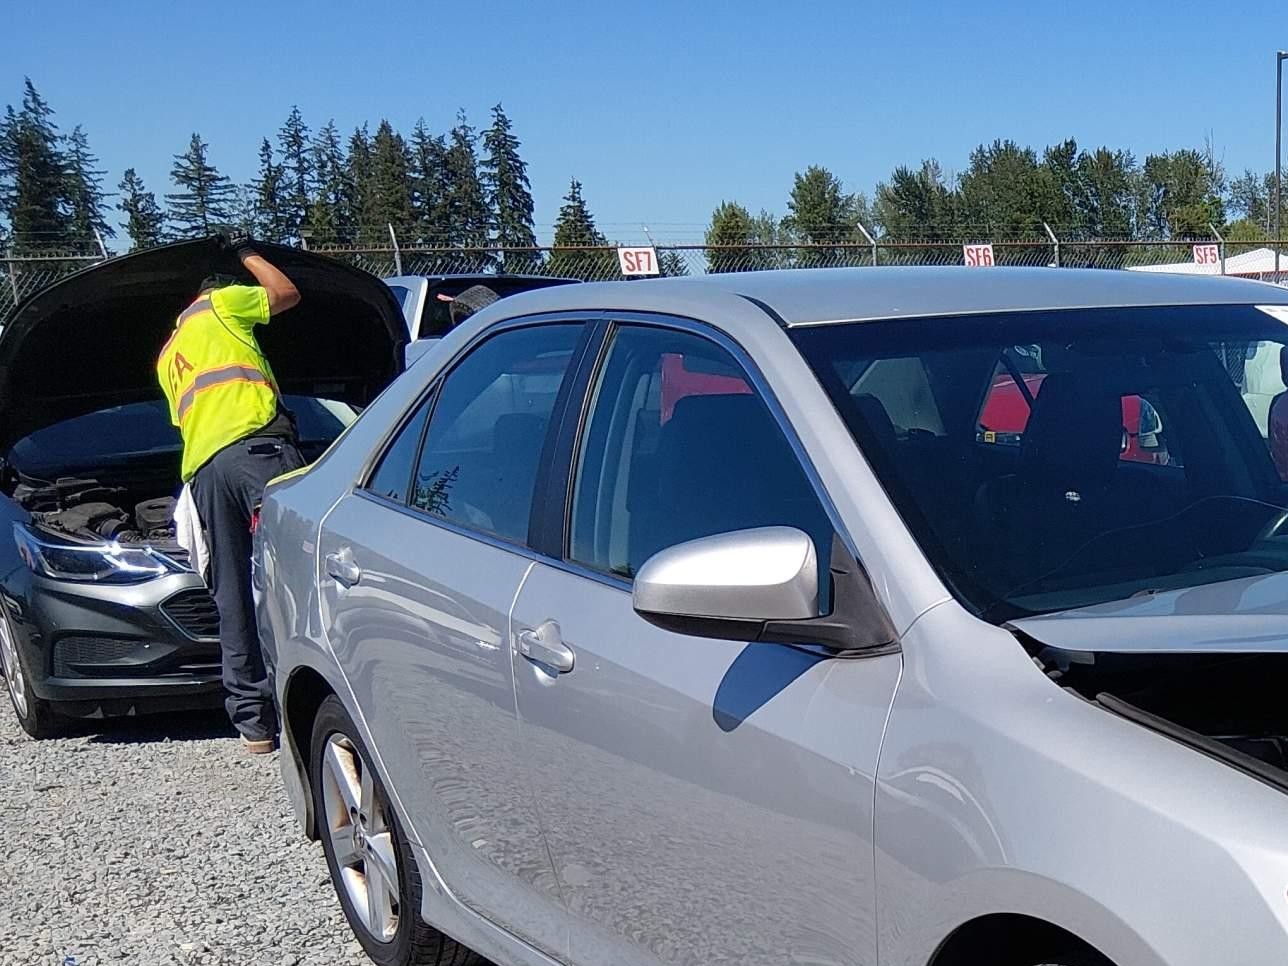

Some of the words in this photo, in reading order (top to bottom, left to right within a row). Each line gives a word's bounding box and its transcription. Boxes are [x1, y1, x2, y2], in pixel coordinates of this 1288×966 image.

[623, 251, 652, 272] SF7
[966, 247, 992, 267] SF6
[1195, 246, 1217, 264] SF5
